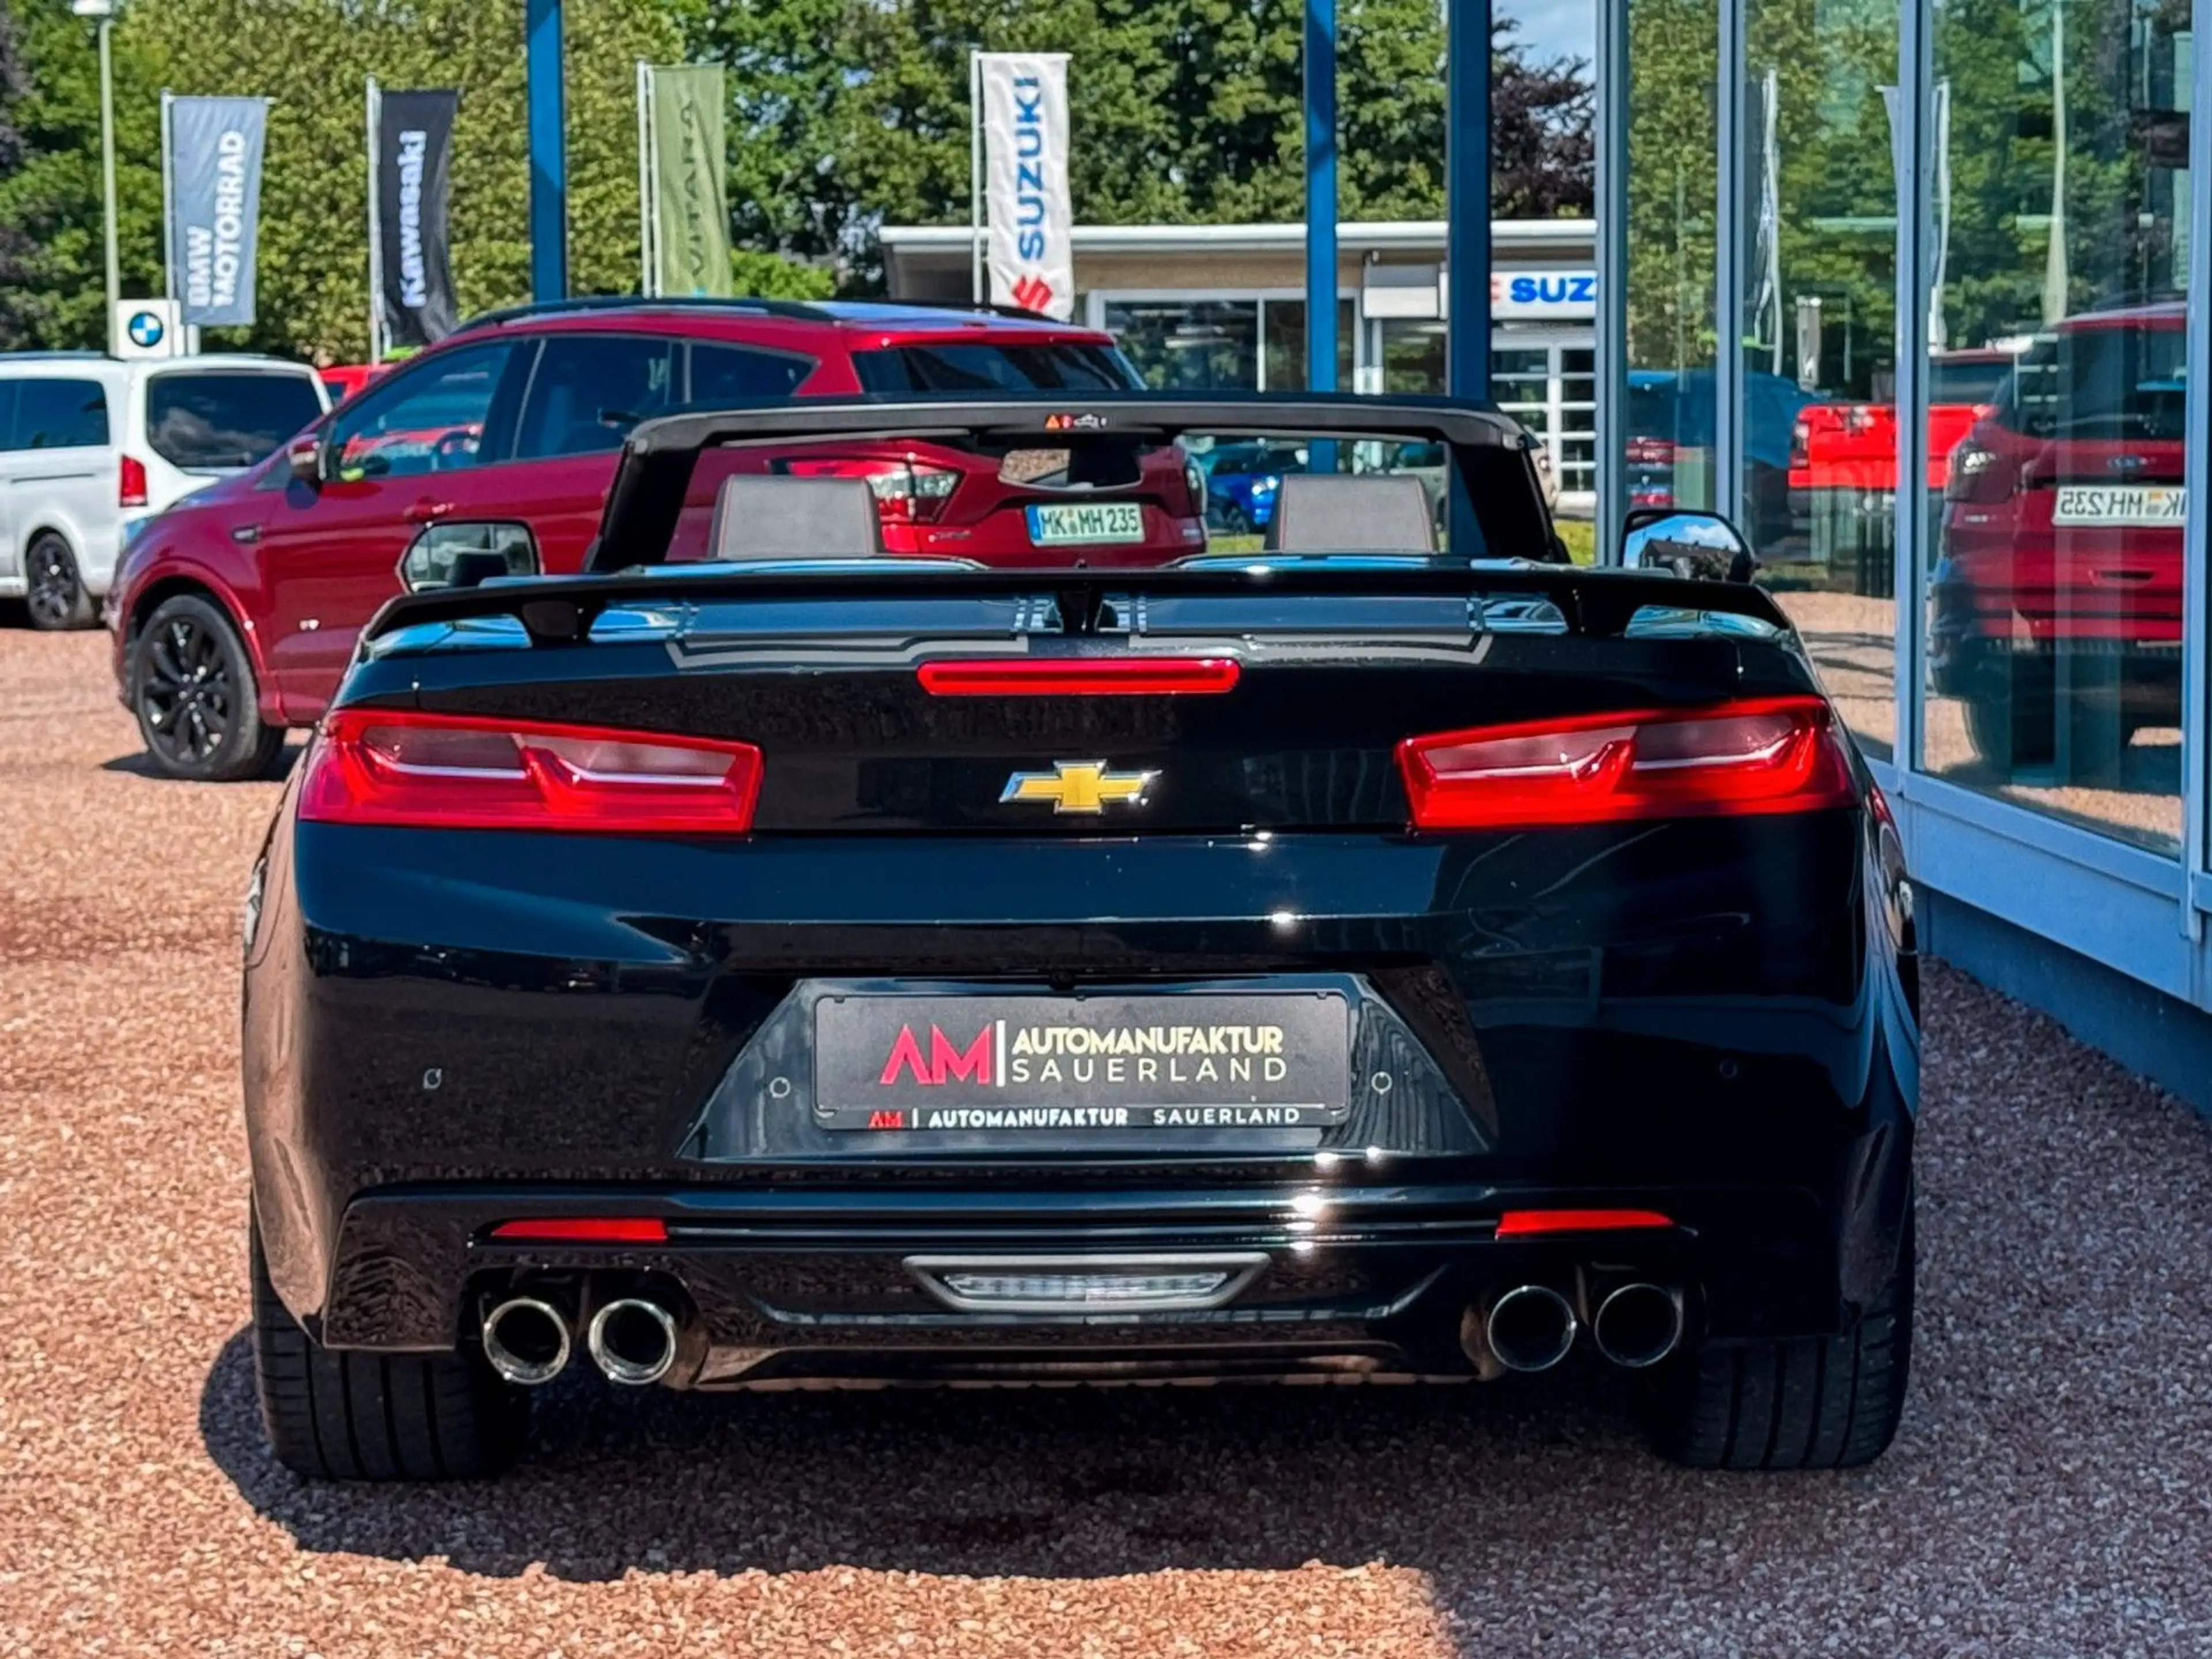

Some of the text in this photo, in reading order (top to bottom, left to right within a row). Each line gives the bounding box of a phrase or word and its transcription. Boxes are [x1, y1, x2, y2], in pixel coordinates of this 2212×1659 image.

[680, 99, 704, 278] VITARA
[1013, 76, 1045, 260] SUZUKI
[211, 130, 245, 307] MOTORRAD
[397, 130, 427, 307] Kawasaki
[187, 225, 212, 307] BMW
[1107, 508, 1139, 533] 235
[879, 1023, 992, 1084] AM
[1012, 1026, 1283, 1055] AUTOMANUFAKTUR
[1012, 1058, 1287, 1083] SAUERLAND
[868, 1107, 1300, 1128] AM AUTOMANUFAKTUR SAUERLAND
